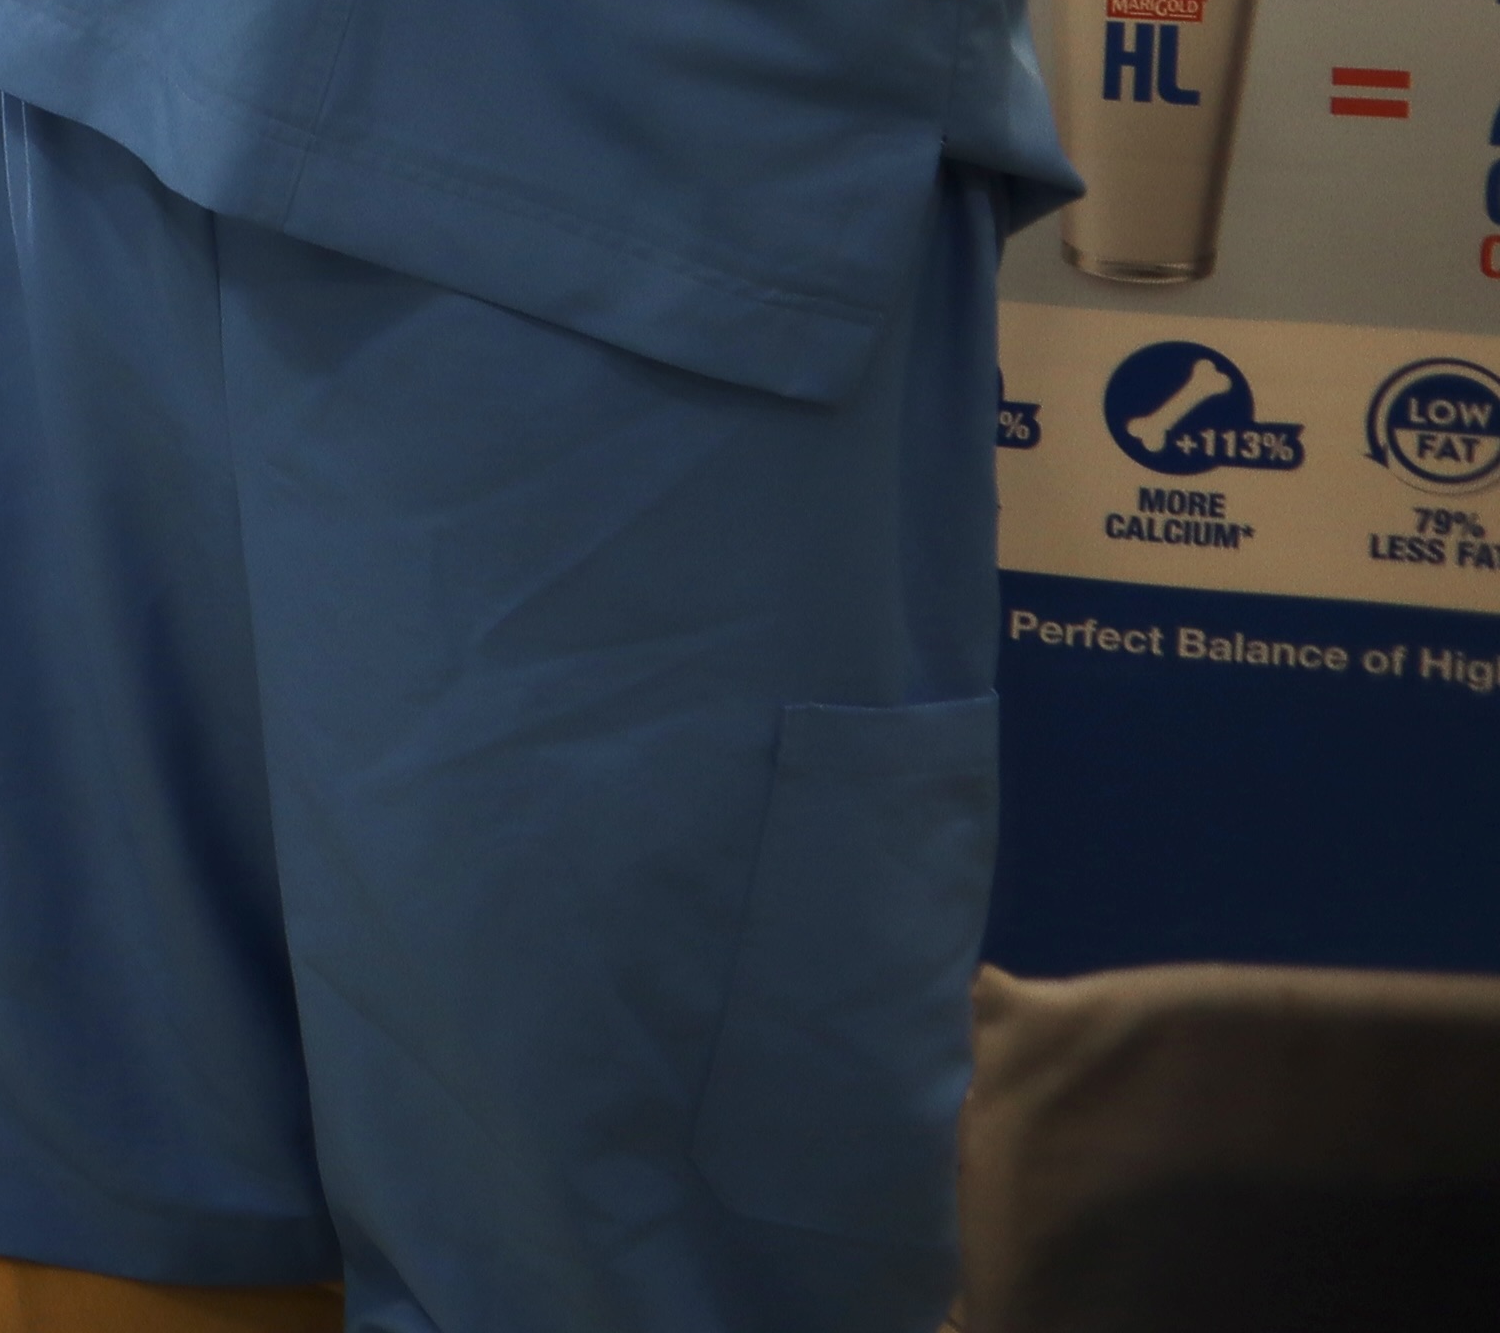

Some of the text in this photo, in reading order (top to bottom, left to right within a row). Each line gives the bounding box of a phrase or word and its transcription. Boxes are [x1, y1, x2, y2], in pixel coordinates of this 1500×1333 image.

[1102, 20, 1201, 106] HL
[1407, 396, 1493, 429] LOW
[1175, 428, 1295, 462] +113%
[1415, 435, 1481, 465] FAT
[1138, 487, 1226, 518] MORE
[1413, 506, 1486, 538] 79%
[1369, 534, 1445, 566] LESS
[1010, 609, 1500, 694] Perfect Balance of Hig
